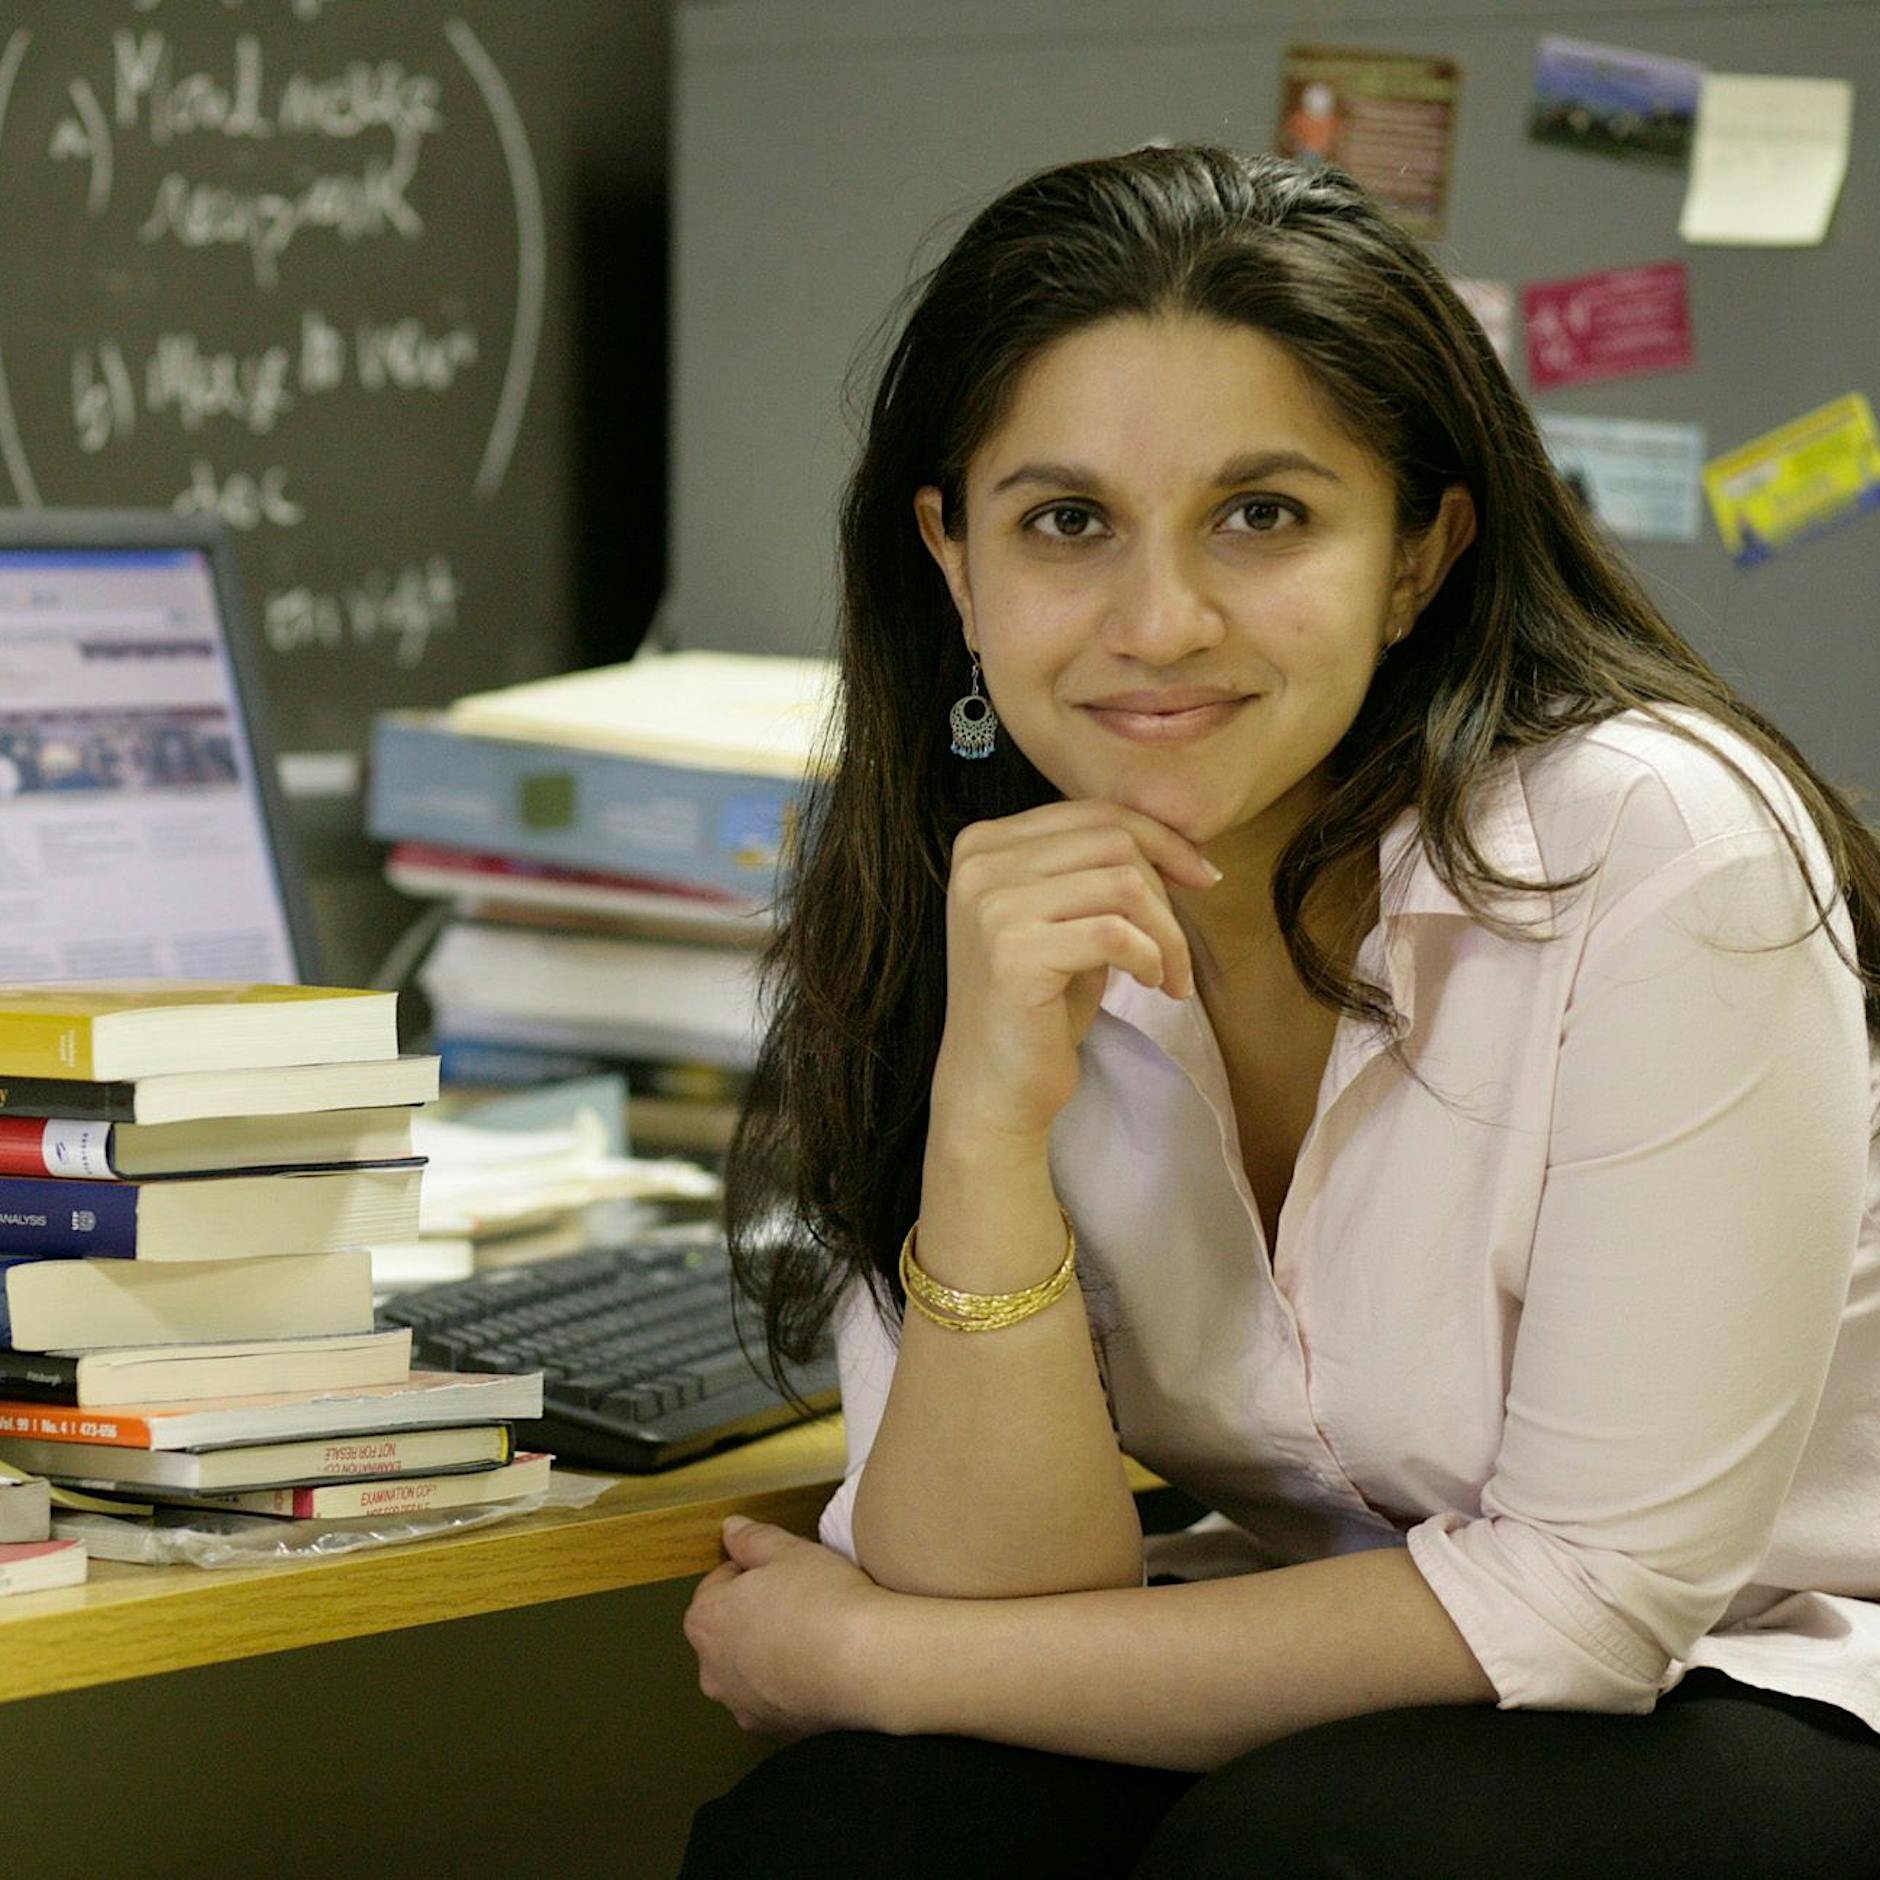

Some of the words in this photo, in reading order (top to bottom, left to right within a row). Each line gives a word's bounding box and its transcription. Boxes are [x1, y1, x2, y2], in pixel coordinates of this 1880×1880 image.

[325, 1447, 357, 1461] RESALE
[359, 1445, 377, 1460] FOR
[378, 1442, 397, 1459] NOT
[360, 1487, 415, 1507] EXAMINATION
